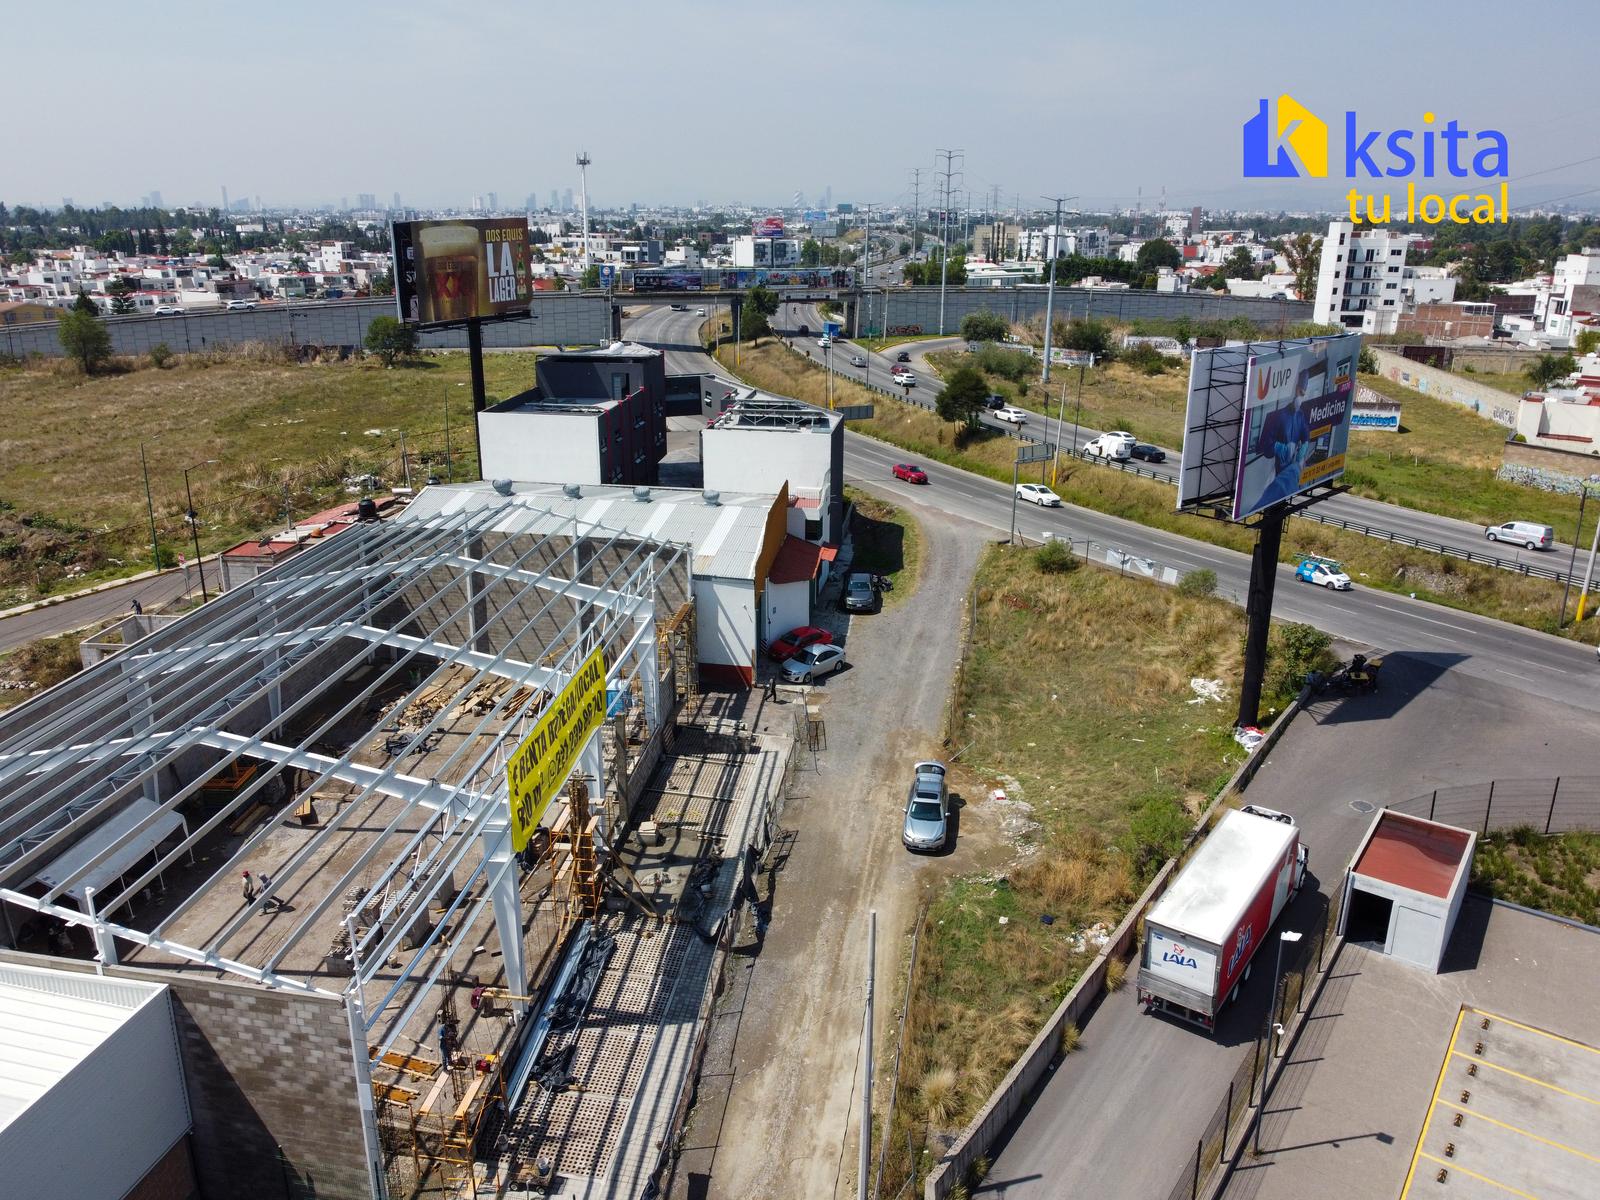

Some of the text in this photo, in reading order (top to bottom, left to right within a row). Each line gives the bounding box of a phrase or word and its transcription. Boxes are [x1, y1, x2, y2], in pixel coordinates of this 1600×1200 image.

[485, 228, 523, 242] DOS EQUIS
[486, 242, 515, 277] LA
[489, 276, 517, 303] LAGER
[1272, 368, 1292, 389] UVP
[1309, 400, 1346, 424] Medicina
[519, 730, 548, 783] RENTA
[1162, 951, 1198, 969] LALA
